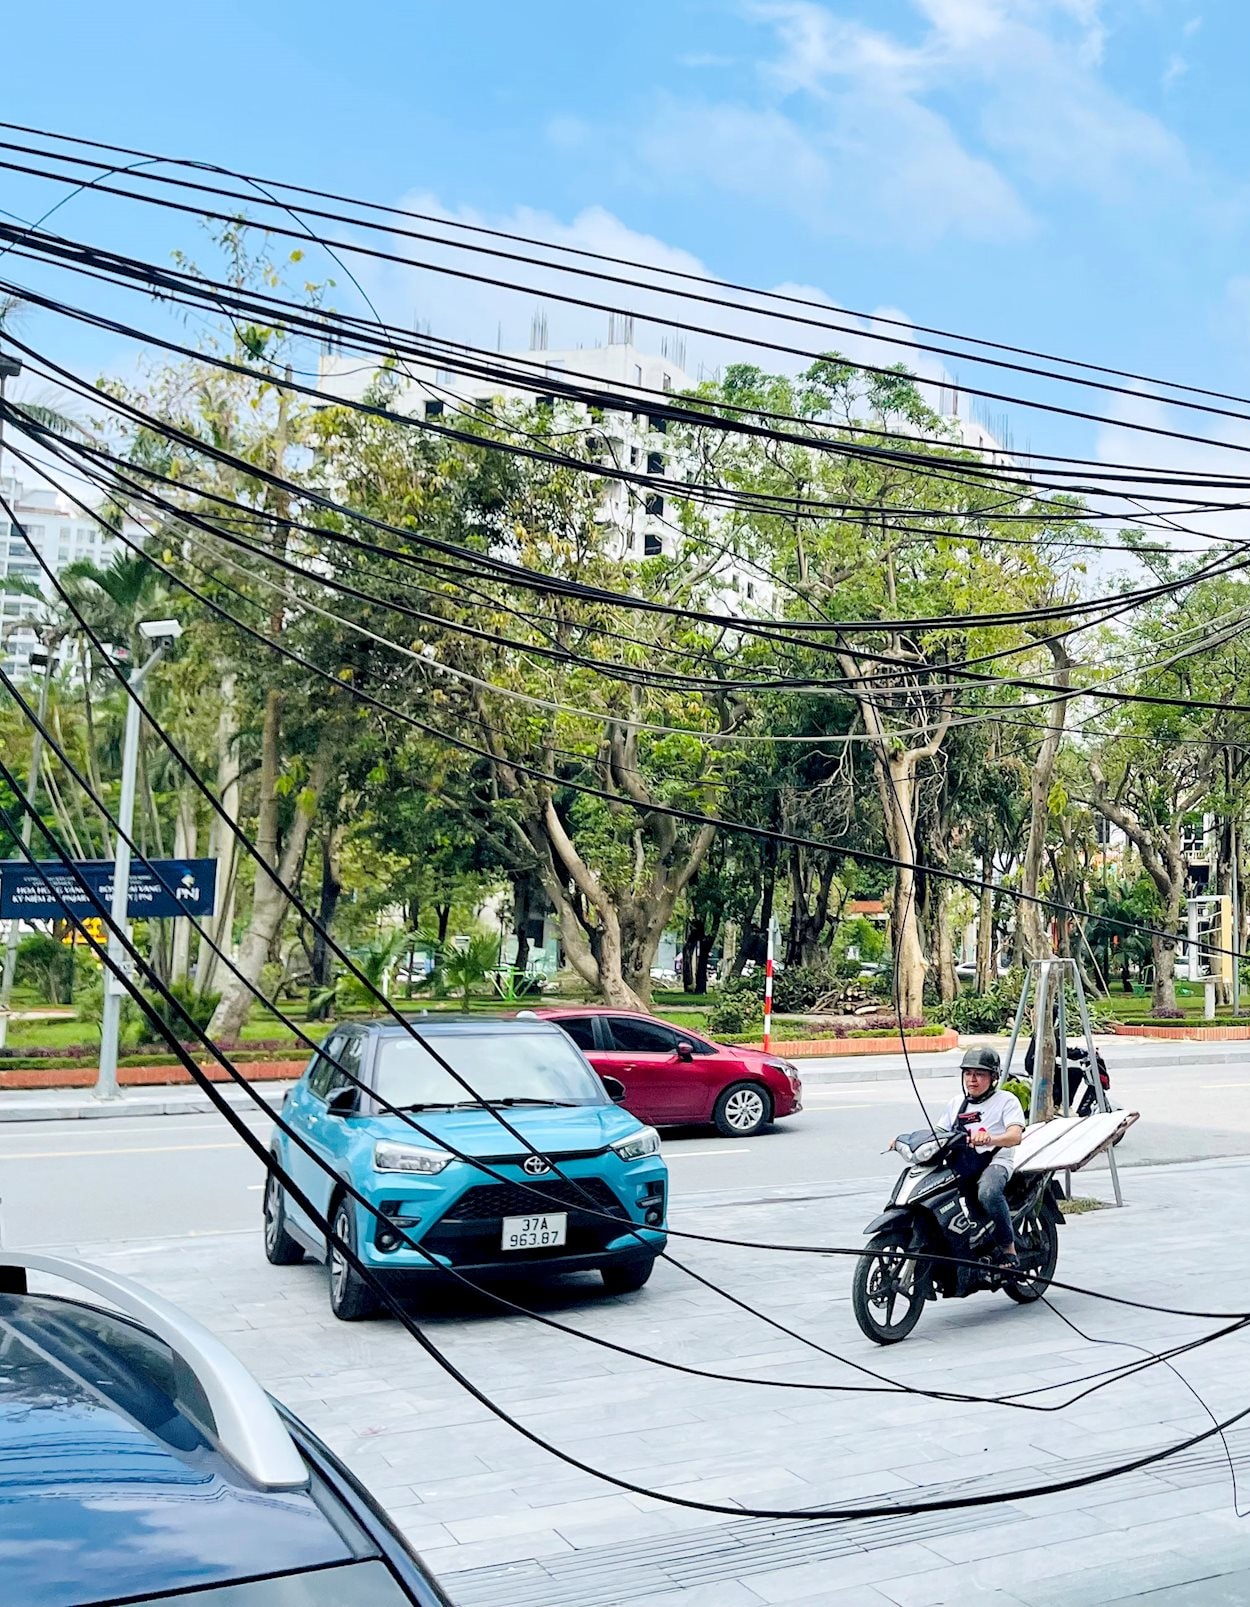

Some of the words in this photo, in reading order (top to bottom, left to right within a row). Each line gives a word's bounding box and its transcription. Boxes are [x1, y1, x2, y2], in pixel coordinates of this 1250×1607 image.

[176, 887, 200, 902] PNJ
[522, 1217, 548, 1232] 37A
[509, 1230, 559, 1247] 963.87
